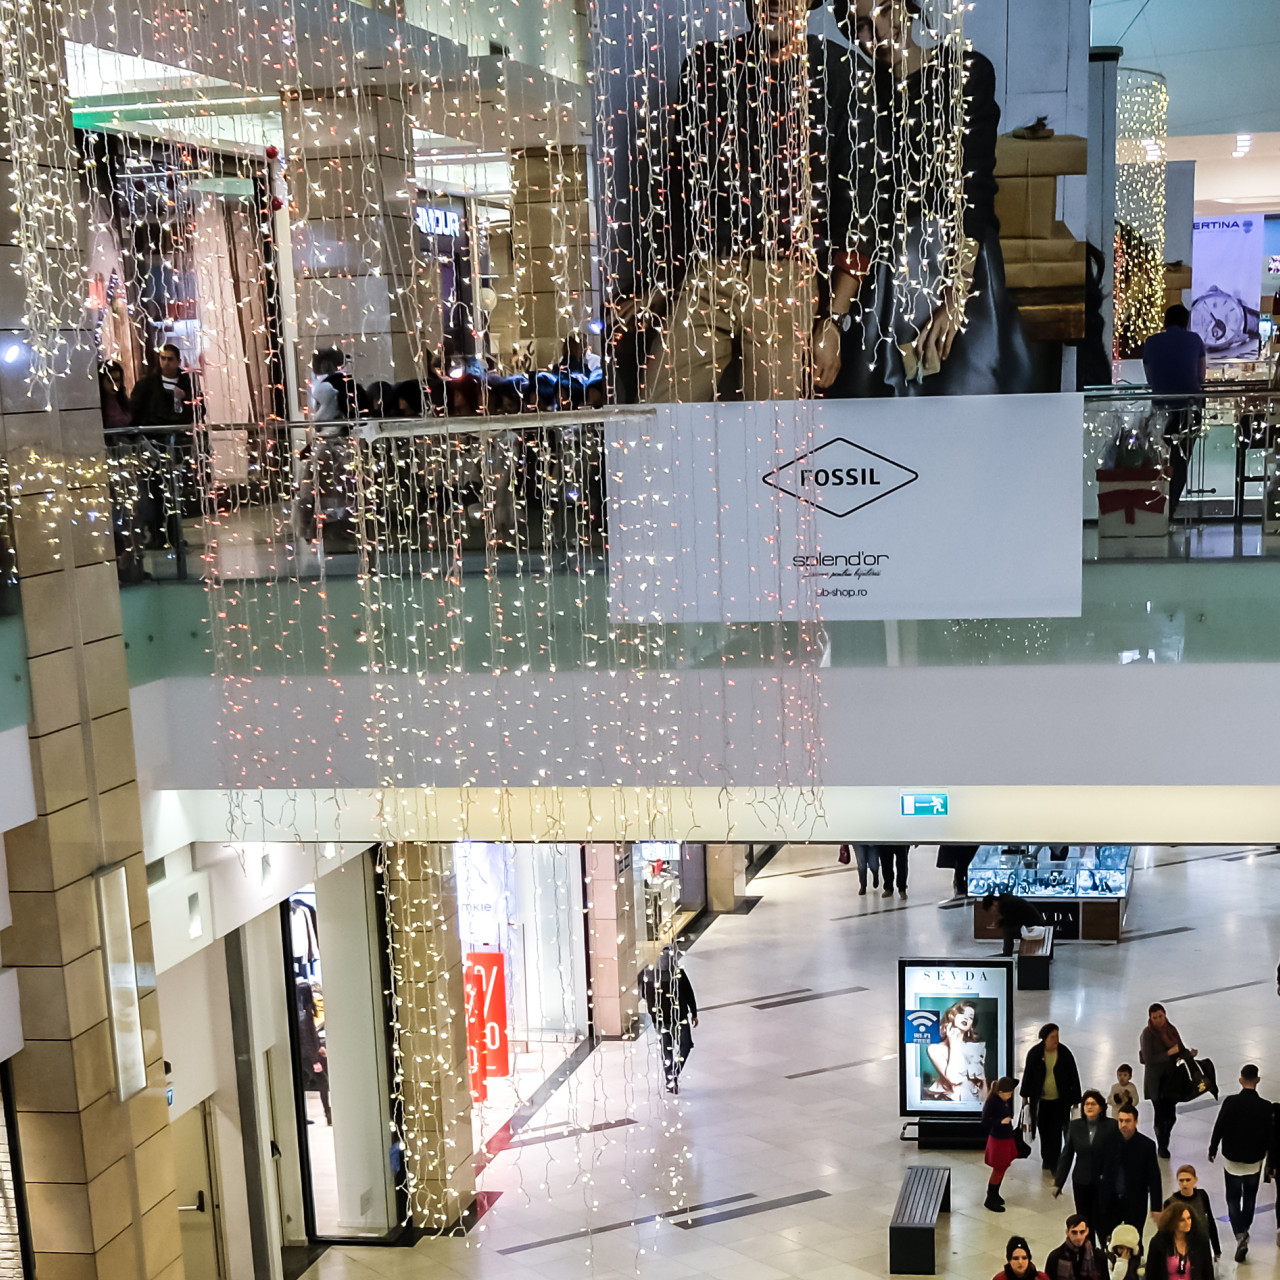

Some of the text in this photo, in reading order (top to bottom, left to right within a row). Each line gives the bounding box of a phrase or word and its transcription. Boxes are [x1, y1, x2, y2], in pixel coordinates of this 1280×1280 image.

[1192, 220, 1240, 230] ERTINA
[800, 467, 881, 487] FOSSIL
[792, 551, 890, 571] splend'or
[461, 903, 492, 912] mkie
[1041, 912, 1073, 922] VDA
[923, 970, 989, 982] SEVDA
